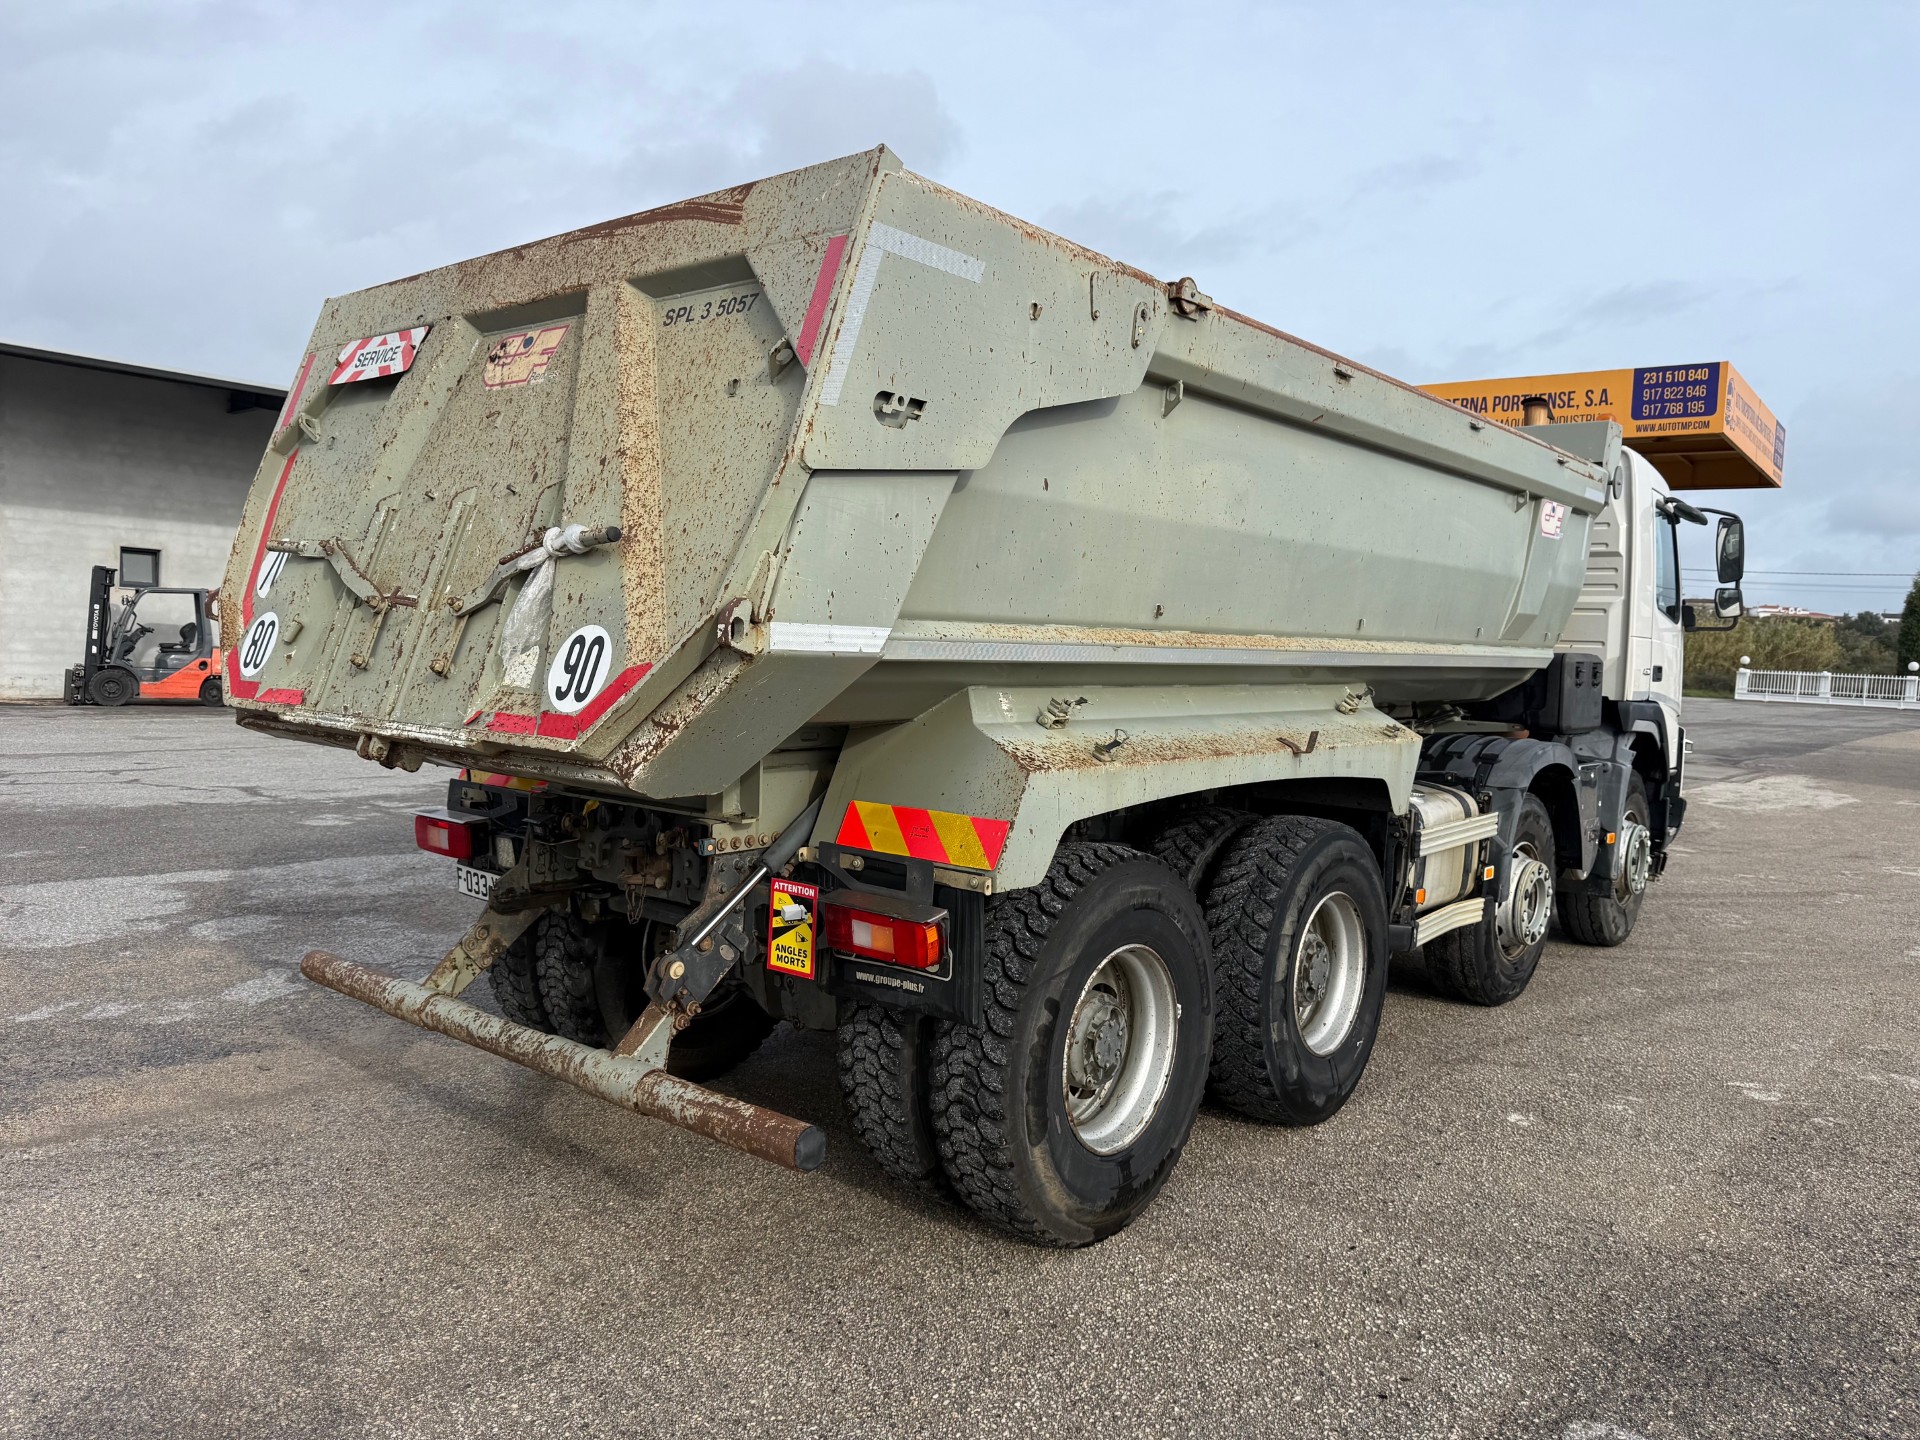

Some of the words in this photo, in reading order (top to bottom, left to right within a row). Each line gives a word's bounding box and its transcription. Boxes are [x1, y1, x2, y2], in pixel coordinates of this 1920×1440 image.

[663, 305, 695, 326] SPL
[701, 301, 712, 319] 3
[716, 292, 760, 317] 5057
[354, 345, 401, 368] SERVICE
[1643, 372, 1663, 385] 231
[1665, 370, 1686, 383] 510
[1688, 368, 1709, 382] 840
[1584, 388, 1614, 407] S.A.
[1642, 388, 1662, 401] 917
[1664, 386, 1684, 399] 822
[1686, 385, 1707, 398] 846
[1642, 404, 1661, 417] 917
[1664, 402, 1683, 415] 768
[1687, 401, 1705, 414] 195
[1636, 420, 1710, 432] WWW.AUTOTMP.COM
[243, 620, 275, 669] 80
[555, 634, 605, 703] 90
[774, 881, 815, 897] ATTENTION
[775, 943, 808, 958] ANGLES
[776, 953, 806, 968] MORTS
[856, 971, 925, 994] www.groupe-plus.fr
